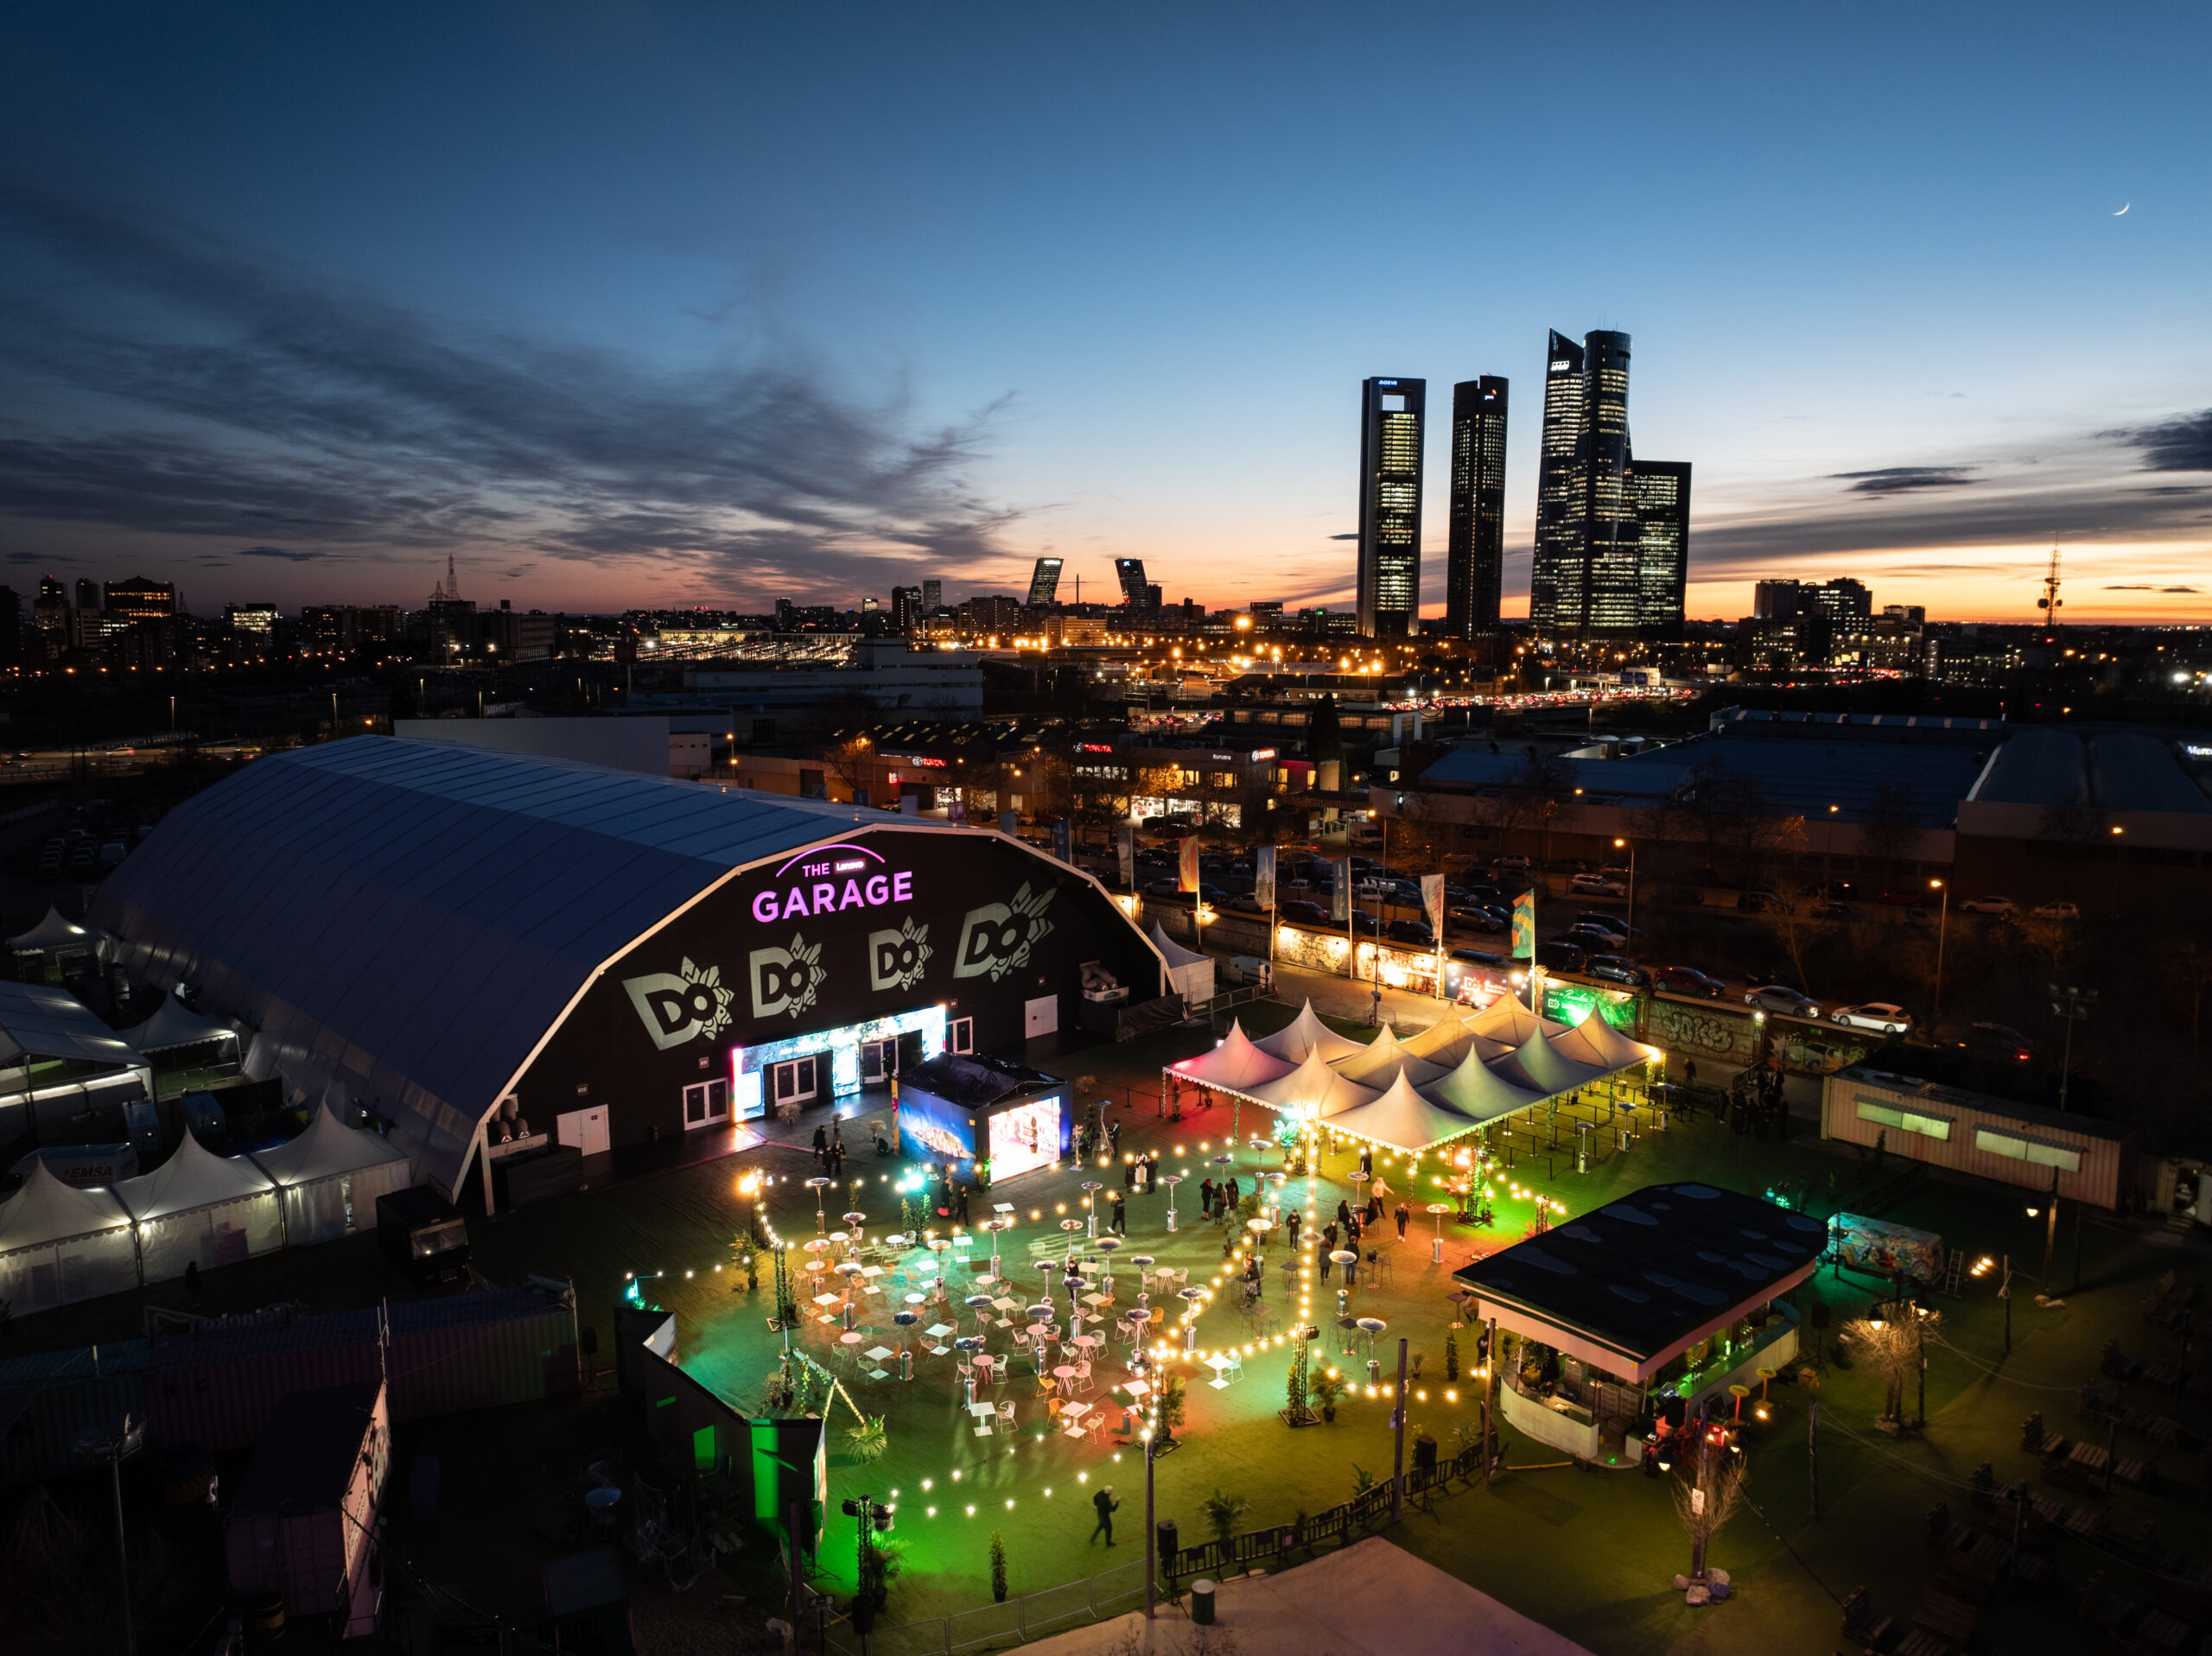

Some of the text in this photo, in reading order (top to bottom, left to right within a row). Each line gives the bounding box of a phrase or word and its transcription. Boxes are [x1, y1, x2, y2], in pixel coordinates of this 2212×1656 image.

[1084, 744, 1112, 752] TOYOTA
[802, 860, 865, 878] THE Lenovo
[752, 871, 913, 923] GARAGE
